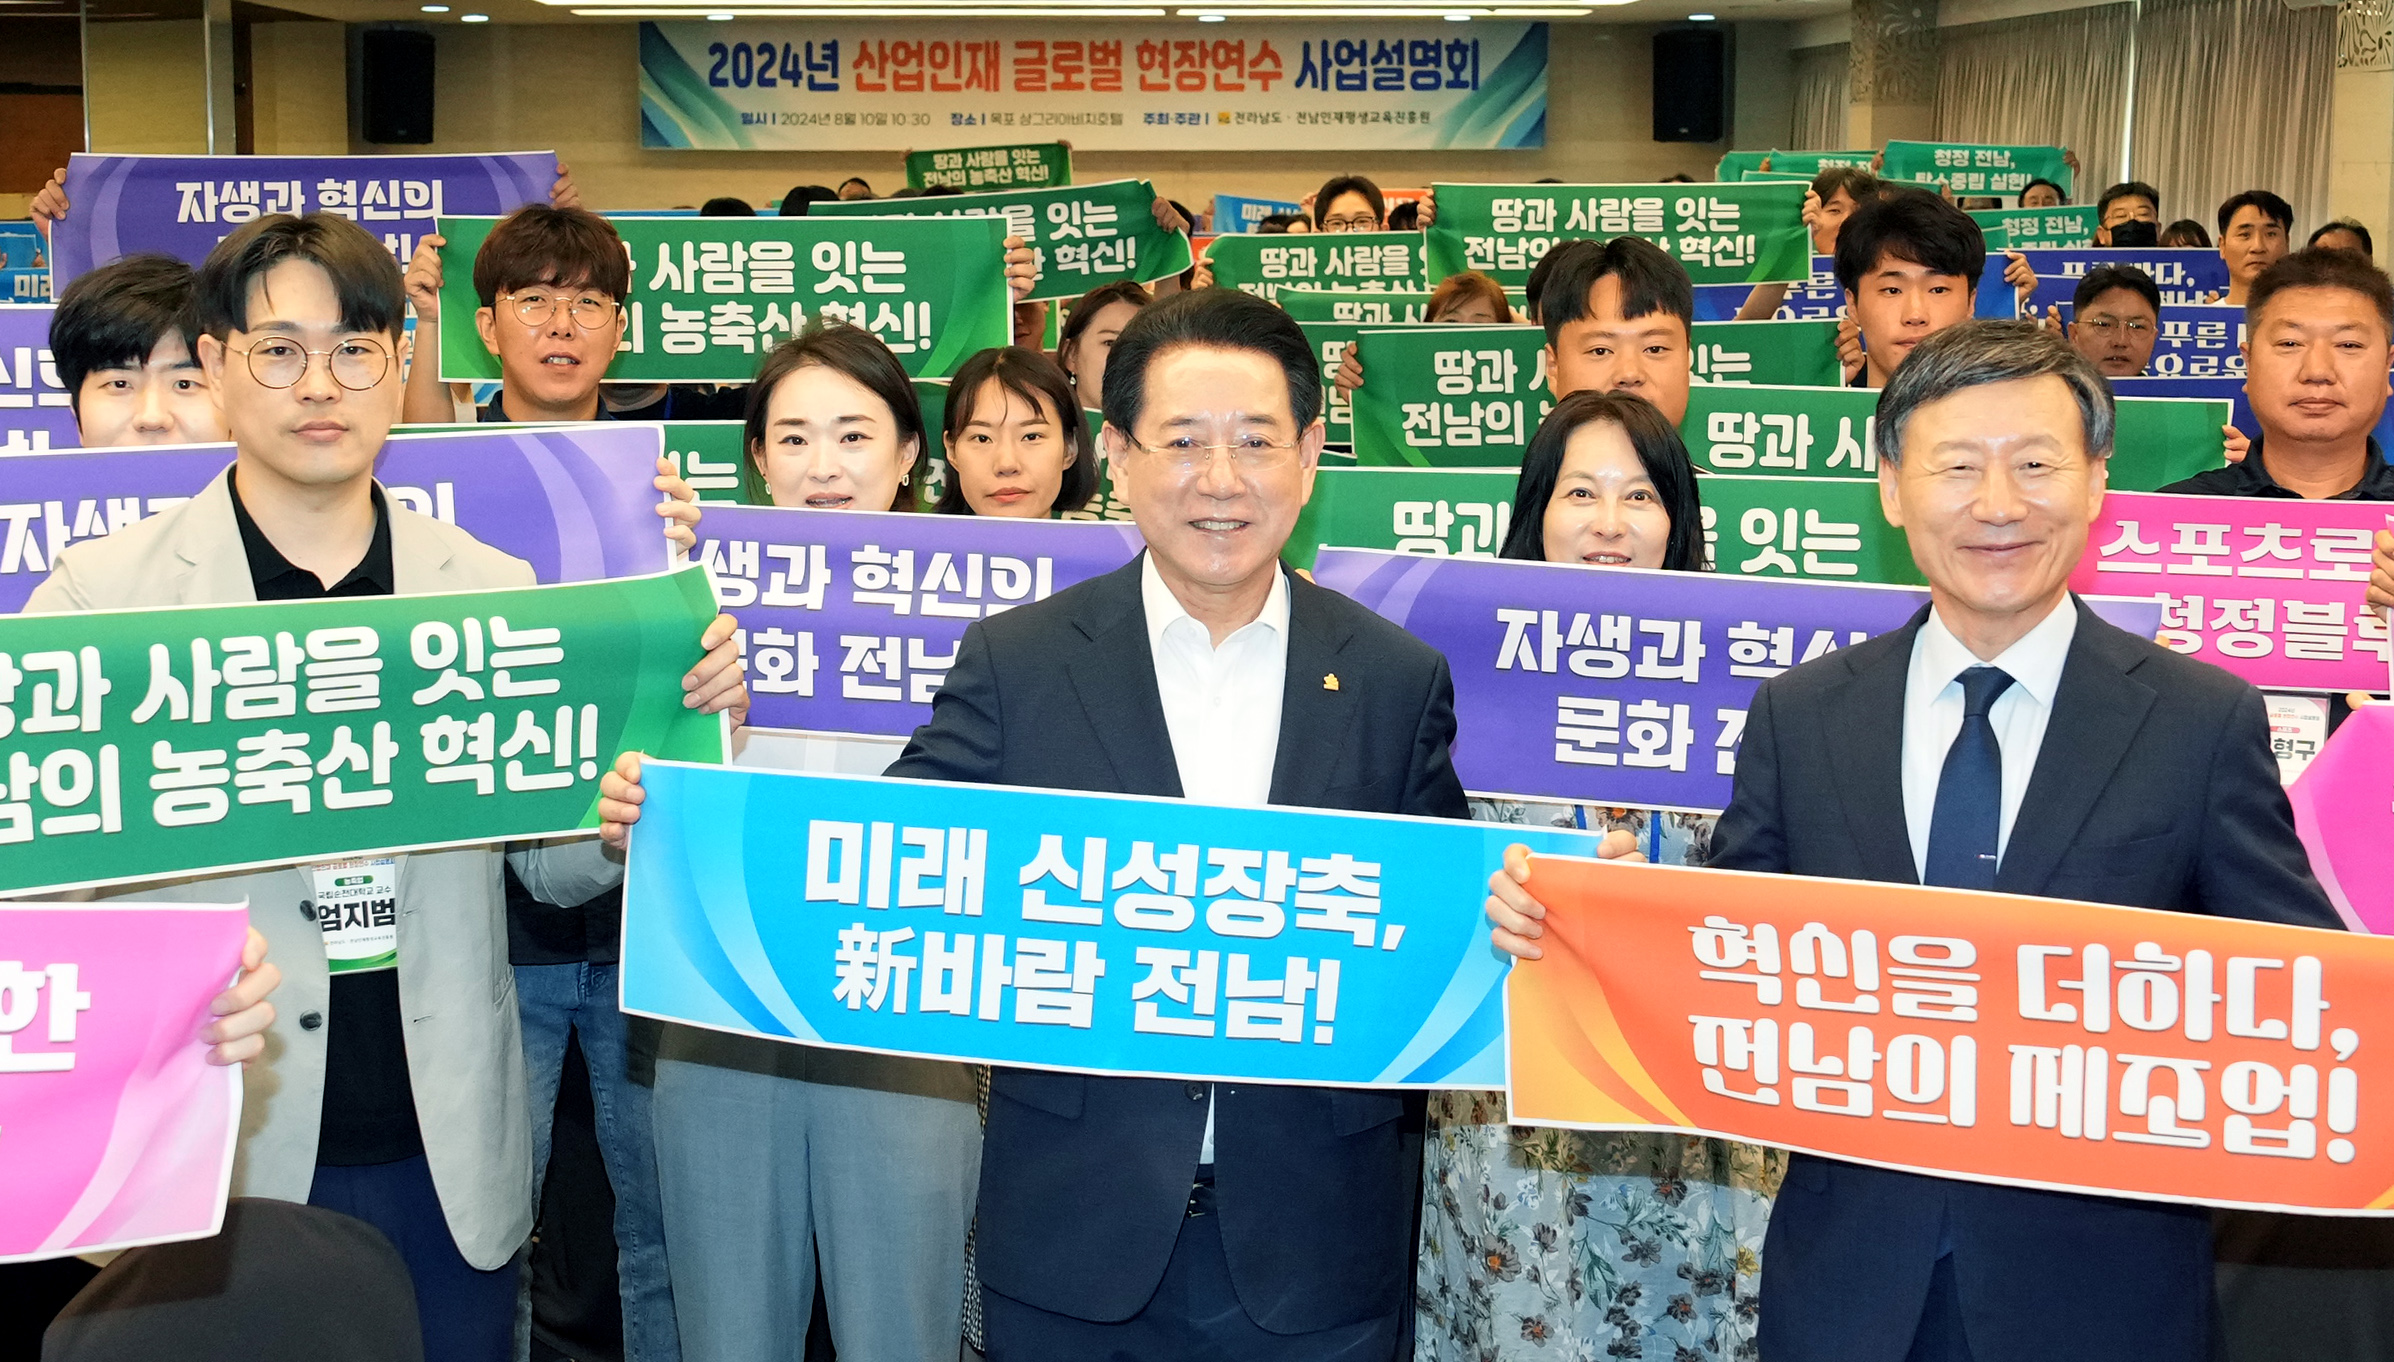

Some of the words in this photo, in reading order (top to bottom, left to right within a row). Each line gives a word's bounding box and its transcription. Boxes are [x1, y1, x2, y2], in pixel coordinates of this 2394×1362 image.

[708, 39, 839, 91] 2024년
[852, 39, 1000, 92] 산업인재
[1012, 38, 1123, 92] 글로벌
[1135, 38, 1283, 92] 현장연수
[1295, 37, 1480, 92] 사업설명회
[741, 112, 767, 126] 일시
[781, 112, 831, 126] 2024년
[834, 112, 856, 126] 8월
[860, 112, 888, 126] 10일
[951, 112, 977, 126] 장소
[990, 112, 1015, 126] 목포
[966, 150, 1008, 168] 사람을
[1011, 149, 1040, 165] 잇는
[1934, 149, 1970, 167] 청정
[1975, 149, 2016, 170] 전남,
[176, 180, 305, 223] 자생과
[317, 178, 443, 221] 혁신의
[1047, 200, 1118, 240] 잇는
[1491, 197, 1557, 233] 땅과
[1565, 196, 1664, 233] 사람을
[1675, 197, 1741, 232] 잇는
[2045, 215, 2089, 235] 전남,
[648, 240, 796, 294] 사람을
[811, 240, 907, 294] 잇는
[1054, 236, 1137, 275] 혁신!
[1260, 246, 1318, 279] 땅과
[1324, 244, 1411, 277] 사람을
[1679, 235, 1756, 268] 혁신!
[2159, 321, 2229, 349] 푸른
[1434, 348, 1518, 396] 땅과
[1401, 400, 1525, 446] 전남의
[1708, 411, 1814, 470] 땅과
[1739, 506, 1862, 575] 잇는
[2097, 520, 2373, 582] 스포츠로
[690, 539, 831, 610] 생과
[851, 544, 1053, 619] 혁신의
[1496, 608, 1706, 683] 자생과
[131, 626, 384, 725] 사람을
[410, 616, 565, 706] 잇는
[1554, 696, 1694, 773] 문화
[149, 720, 398, 828] 농축산
[420, 702, 600, 796] 혁신!
[804, 818, 989, 918] 미래
[1019, 832, 1407, 952] 신성장축,
[317, 898, 396, 932] 엄지범
[832, 921, 1107, 1030] 新바람
[1131, 946, 1343, 1046] 전남!
[1687, 914, 1981, 1022] 혁신을
[2016, 940, 2360, 1062] 더하다,
[1687, 1013, 1977, 1128] 전남의
[2007, 1042, 2359, 1165] 제조업!
